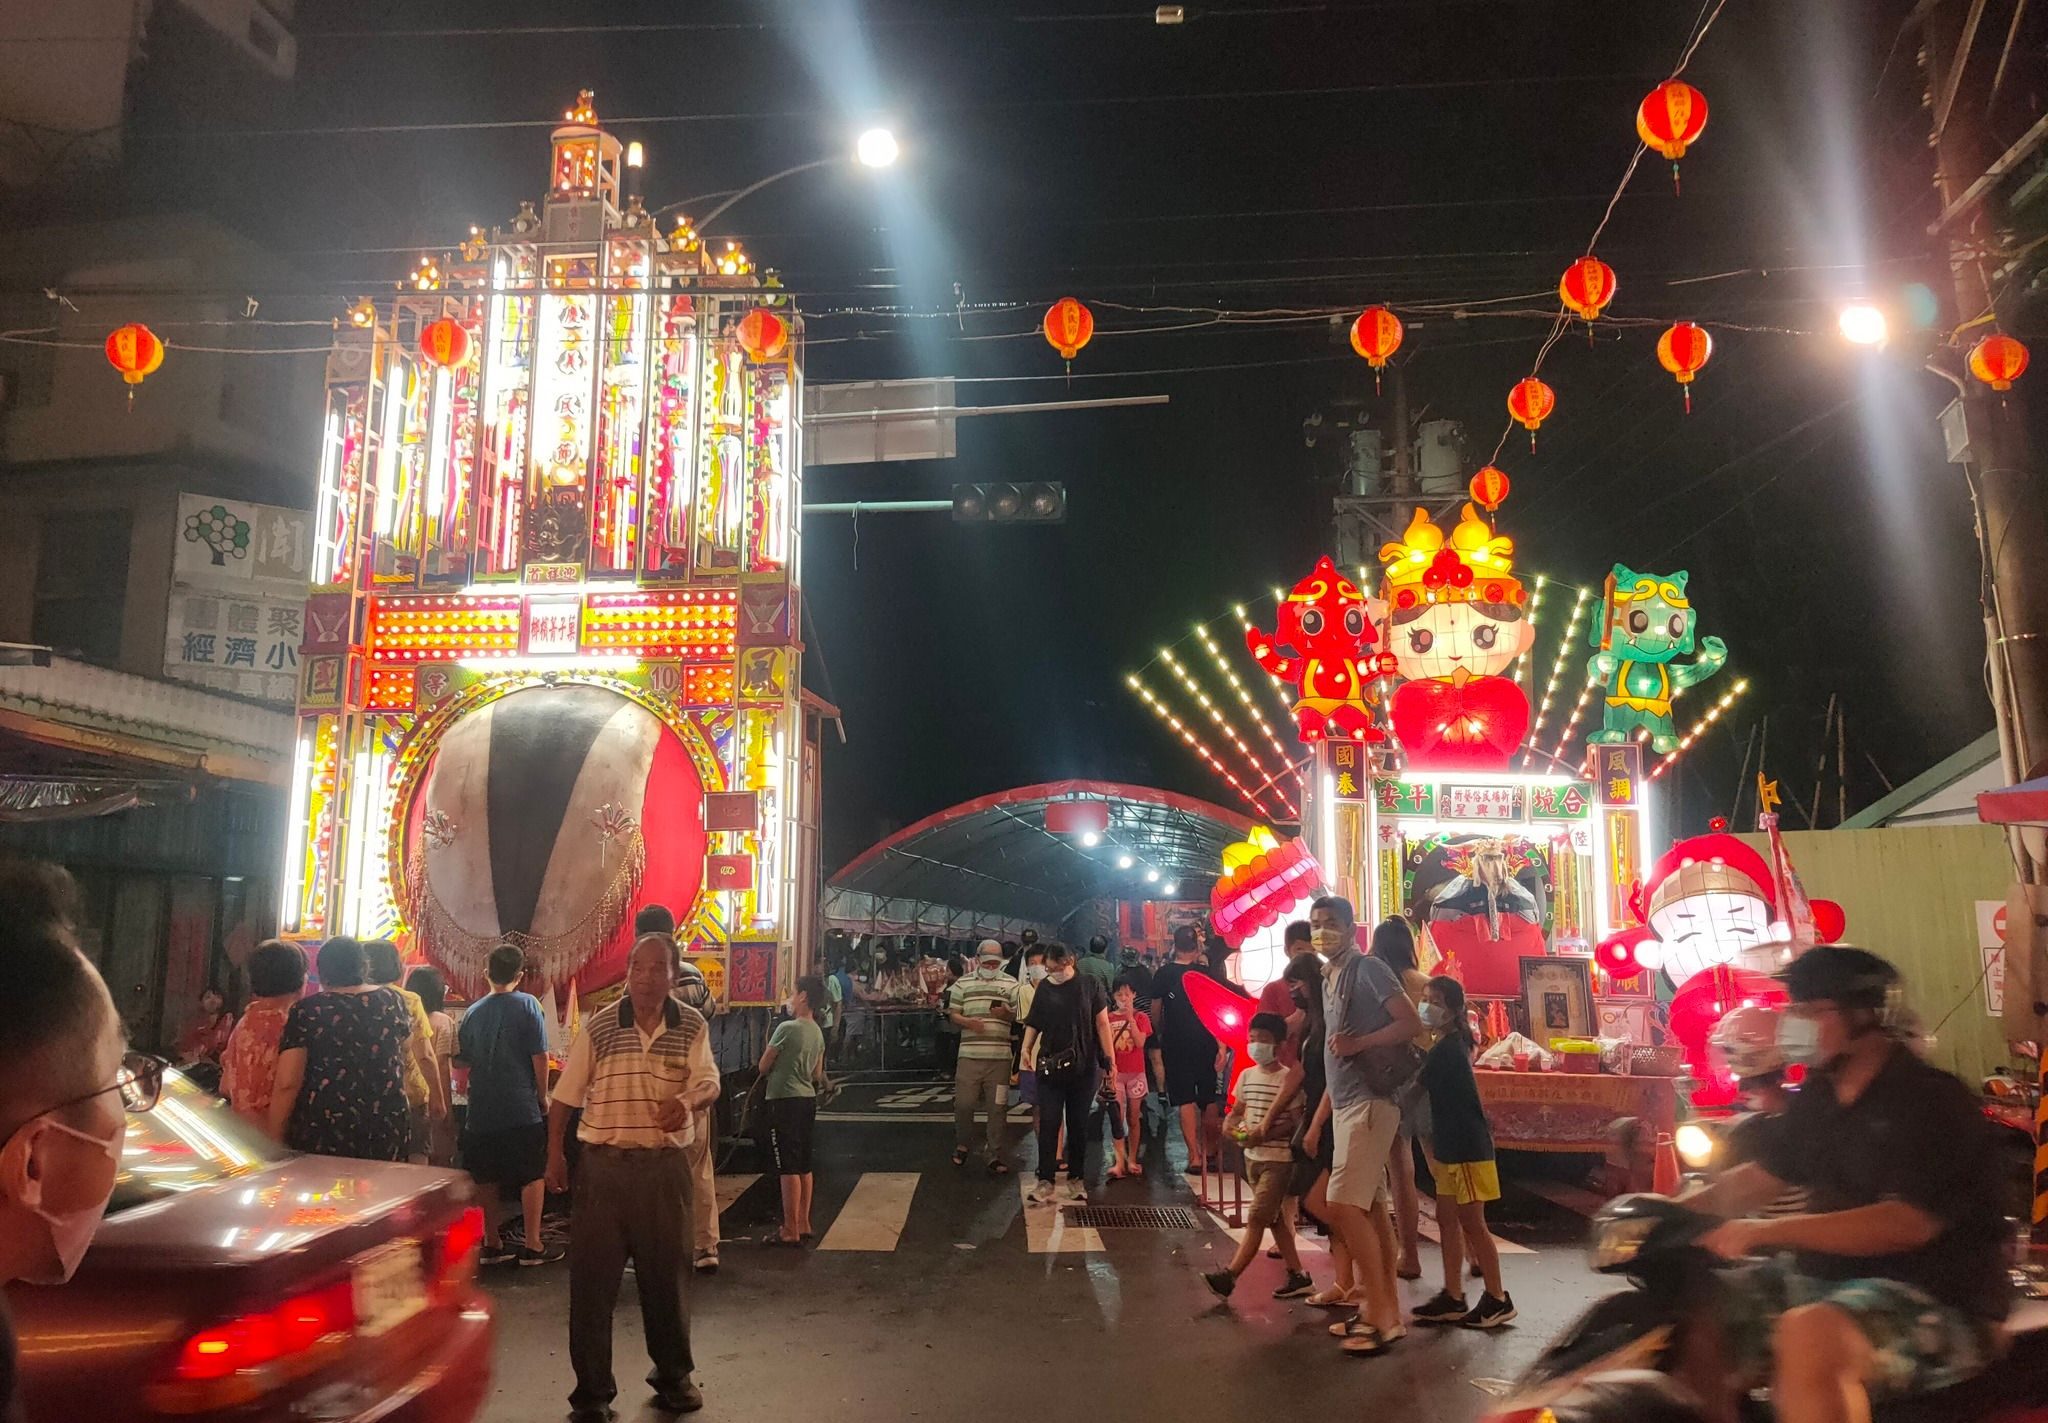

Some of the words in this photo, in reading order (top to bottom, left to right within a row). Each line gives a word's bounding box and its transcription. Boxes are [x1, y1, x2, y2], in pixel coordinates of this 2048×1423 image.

[651, 665, 679, 691] 10
[1336, 745, 1357, 795] 國泰
[1608, 750, 1631, 802] 風調
[1378, 824, 1394, 843] 等
